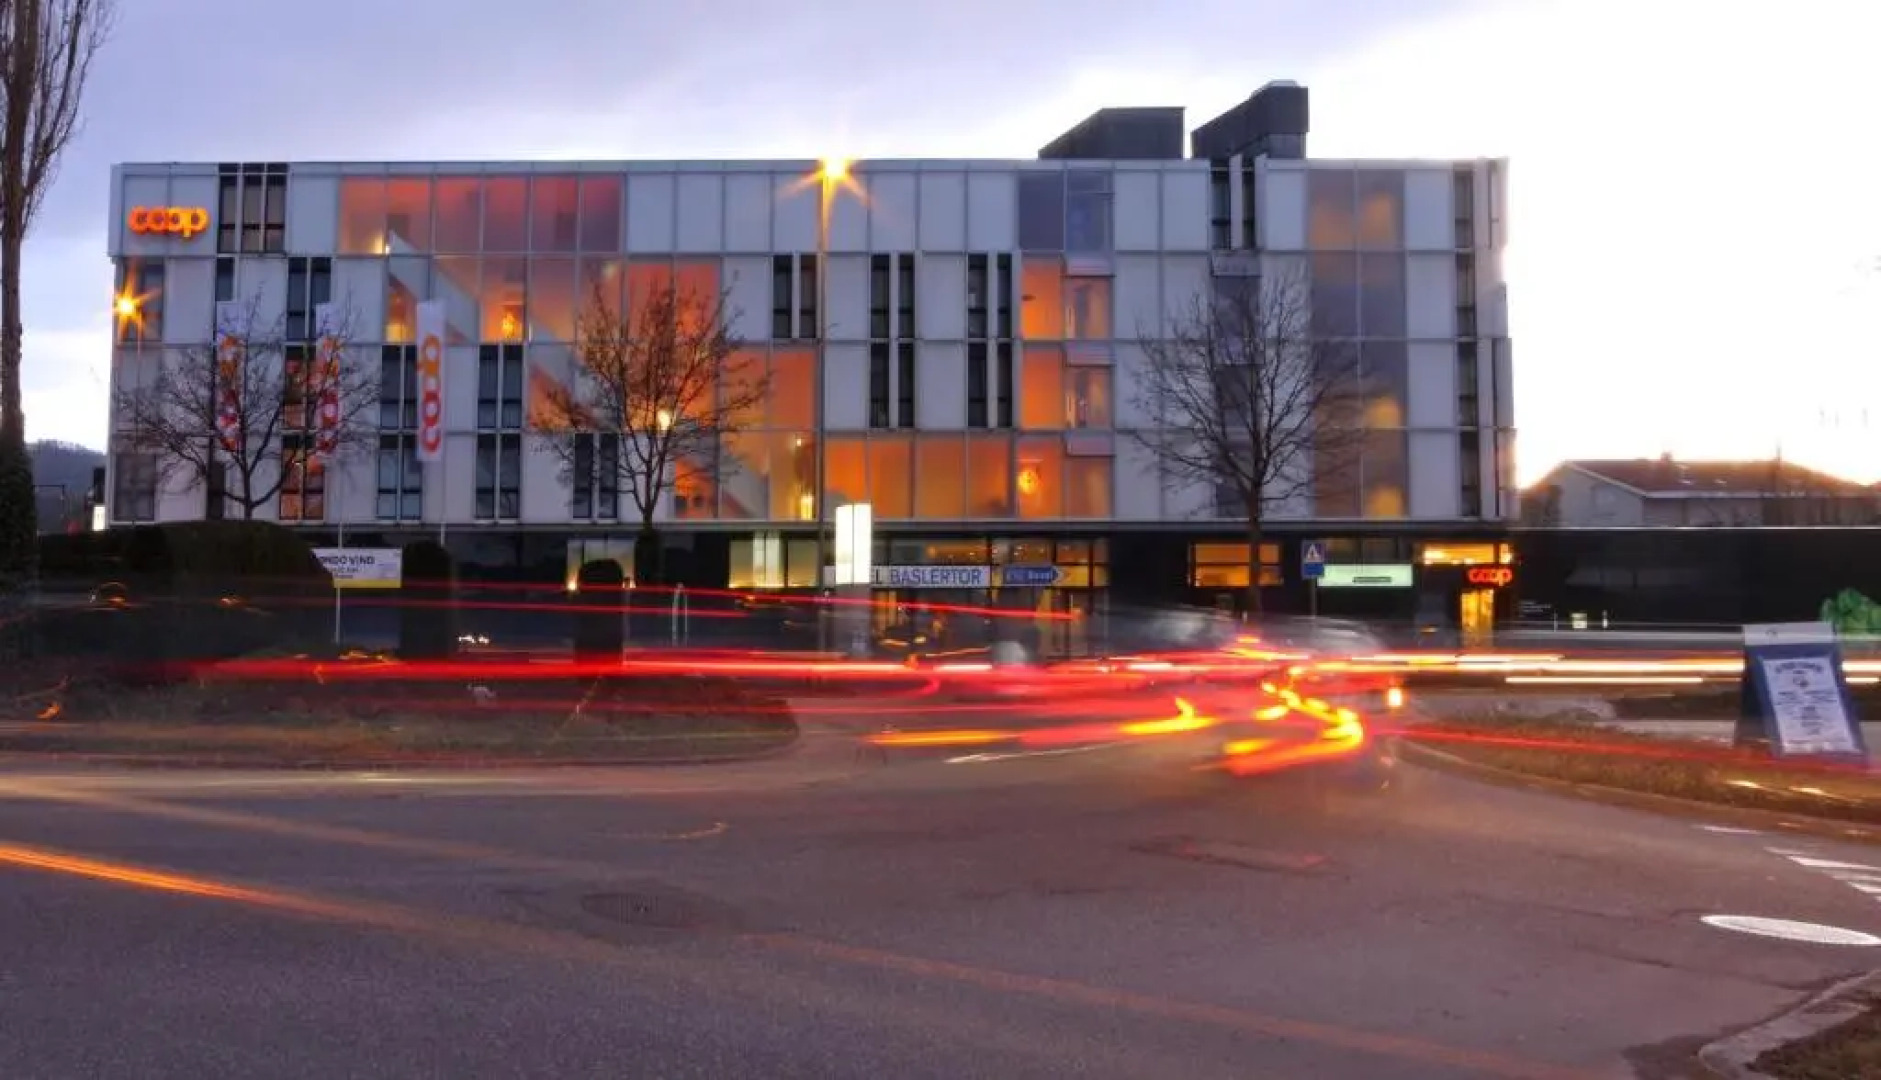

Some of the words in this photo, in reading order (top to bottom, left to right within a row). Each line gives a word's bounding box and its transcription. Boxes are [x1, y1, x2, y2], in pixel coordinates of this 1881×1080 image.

[127, 205, 208, 237] coop
[891, 568, 982, 585] BASLERTOR
[1468, 568, 1513, 586] coop
